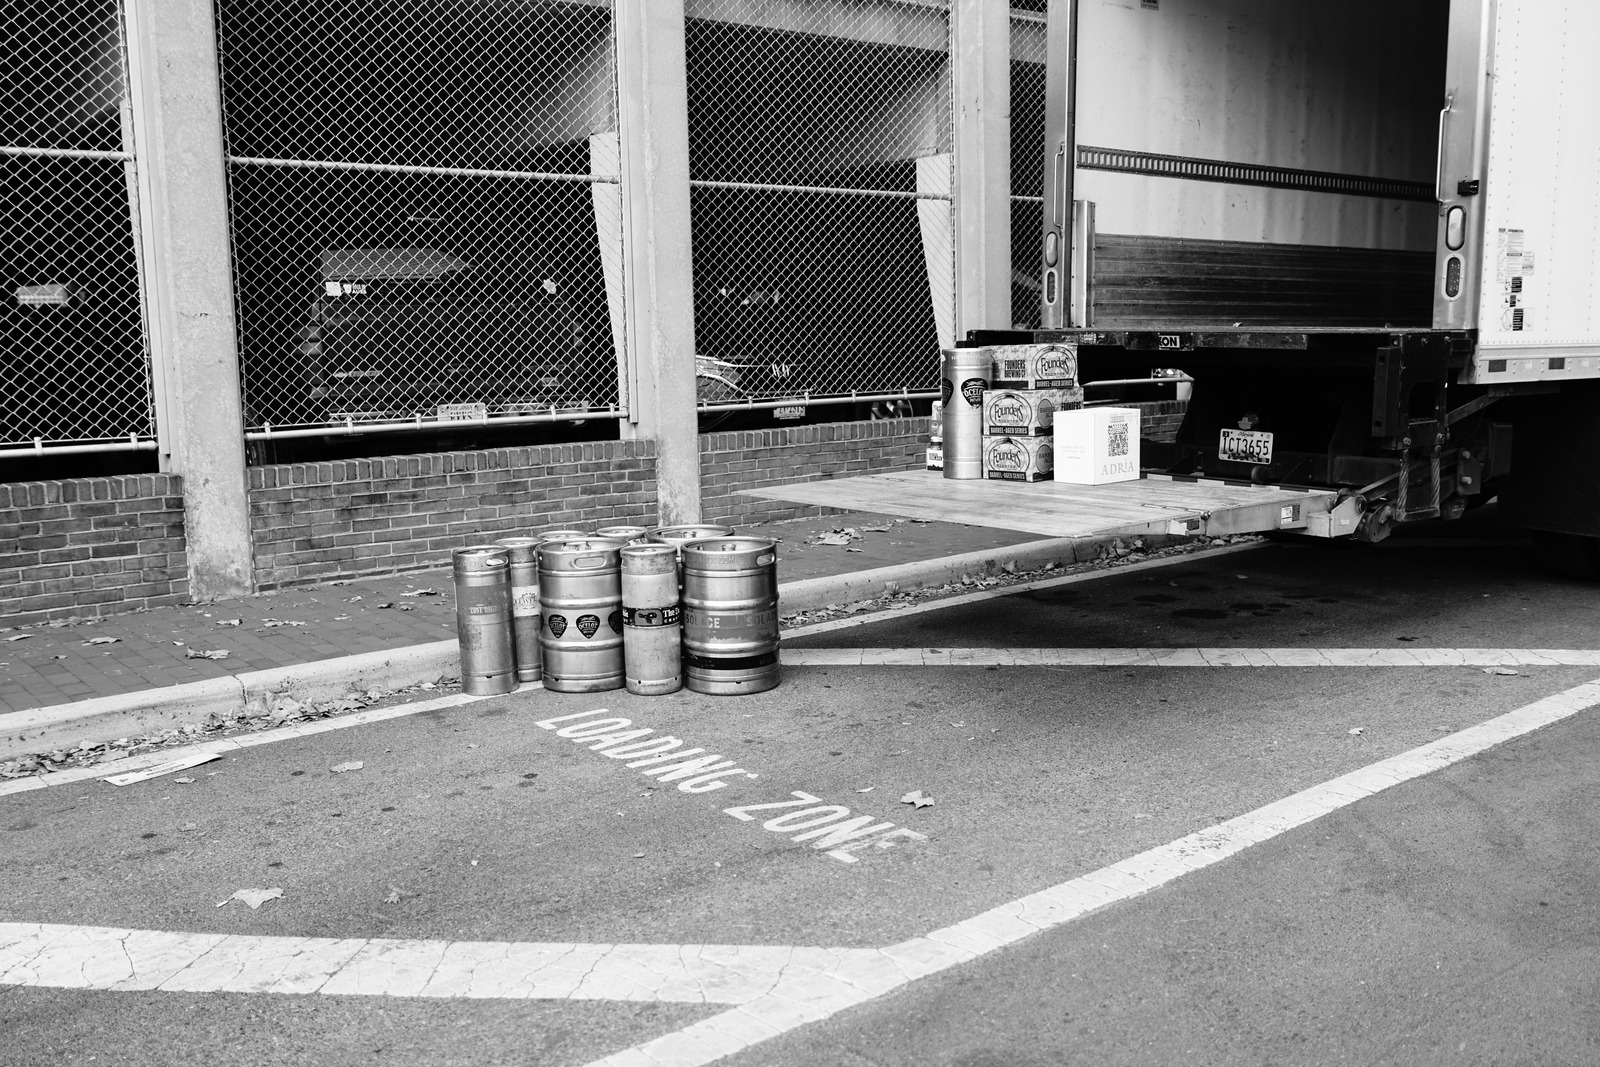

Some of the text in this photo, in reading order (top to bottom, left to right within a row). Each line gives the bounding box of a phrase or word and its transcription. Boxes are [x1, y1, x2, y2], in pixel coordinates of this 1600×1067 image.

[1004, 359, 1026, 370] FOUNDERS
[1041, 357, 1069, 374] Founders
[995, 404, 1023, 422] Founders
[994, 449, 1021, 468] Founders
[534, 708, 759, 793] LOADING
[722, 790, 928, 864] ZONE
